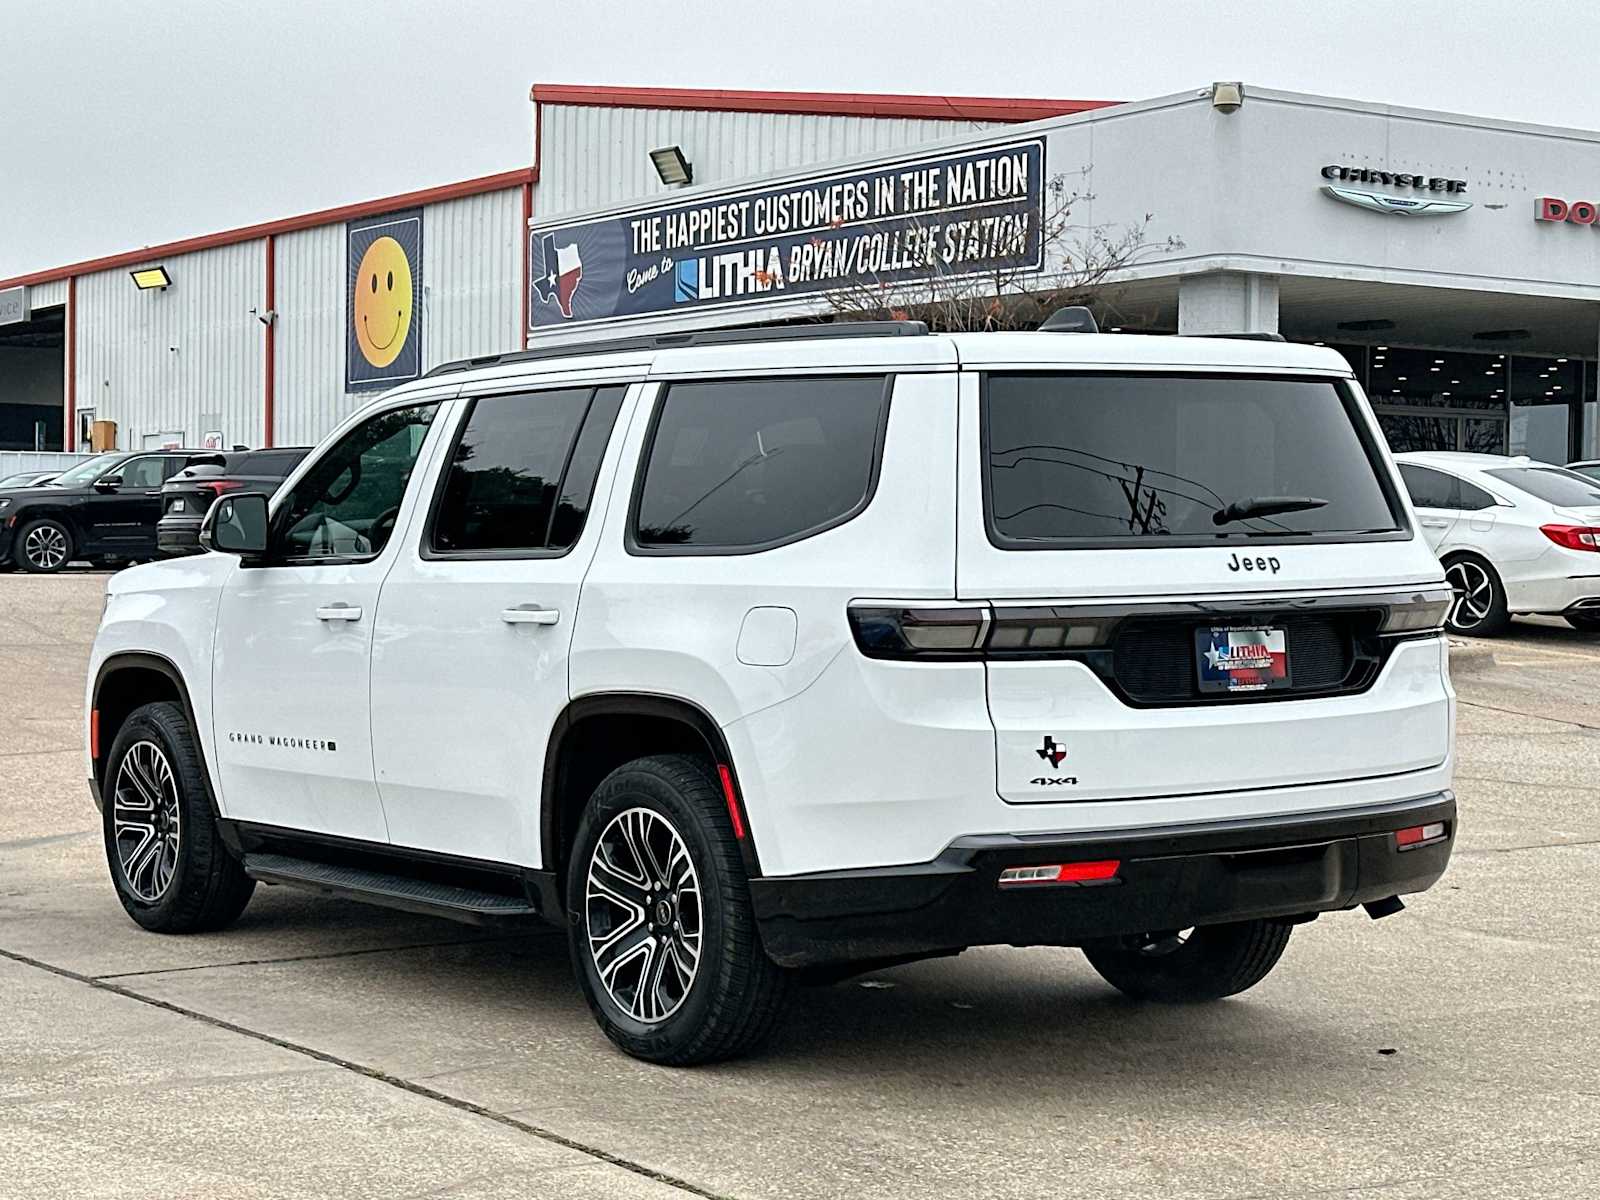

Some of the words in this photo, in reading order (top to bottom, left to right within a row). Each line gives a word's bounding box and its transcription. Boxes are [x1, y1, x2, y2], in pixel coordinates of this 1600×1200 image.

[1320, 165, 1467, 193] CHRYSLER
[631, 217, 662, 254] THE
[666, 201, 750, 249] HAPPIEST
[754, 180, 869, 235] CUSTOMERS
[874, 175, 895, 216] IN
[901, 167, 940, 212] THE
[946, 152, 1028, 205] NATION
[698, 246, 785, 300] LITHIA
[788, 226, 941, 283] BRYAN/COLLEGE
[942, 212, 1029, 263] STATION
[626, 268, 659, 294] Come
[661, 256, 674, 273] to
[1227, 553, 1281, 574] Jeep
[1229, 644, 1269, 659] LITHIA
[228, 732, 263, 744] GRAND
[269, 736, 326, 750] WAGONEER
